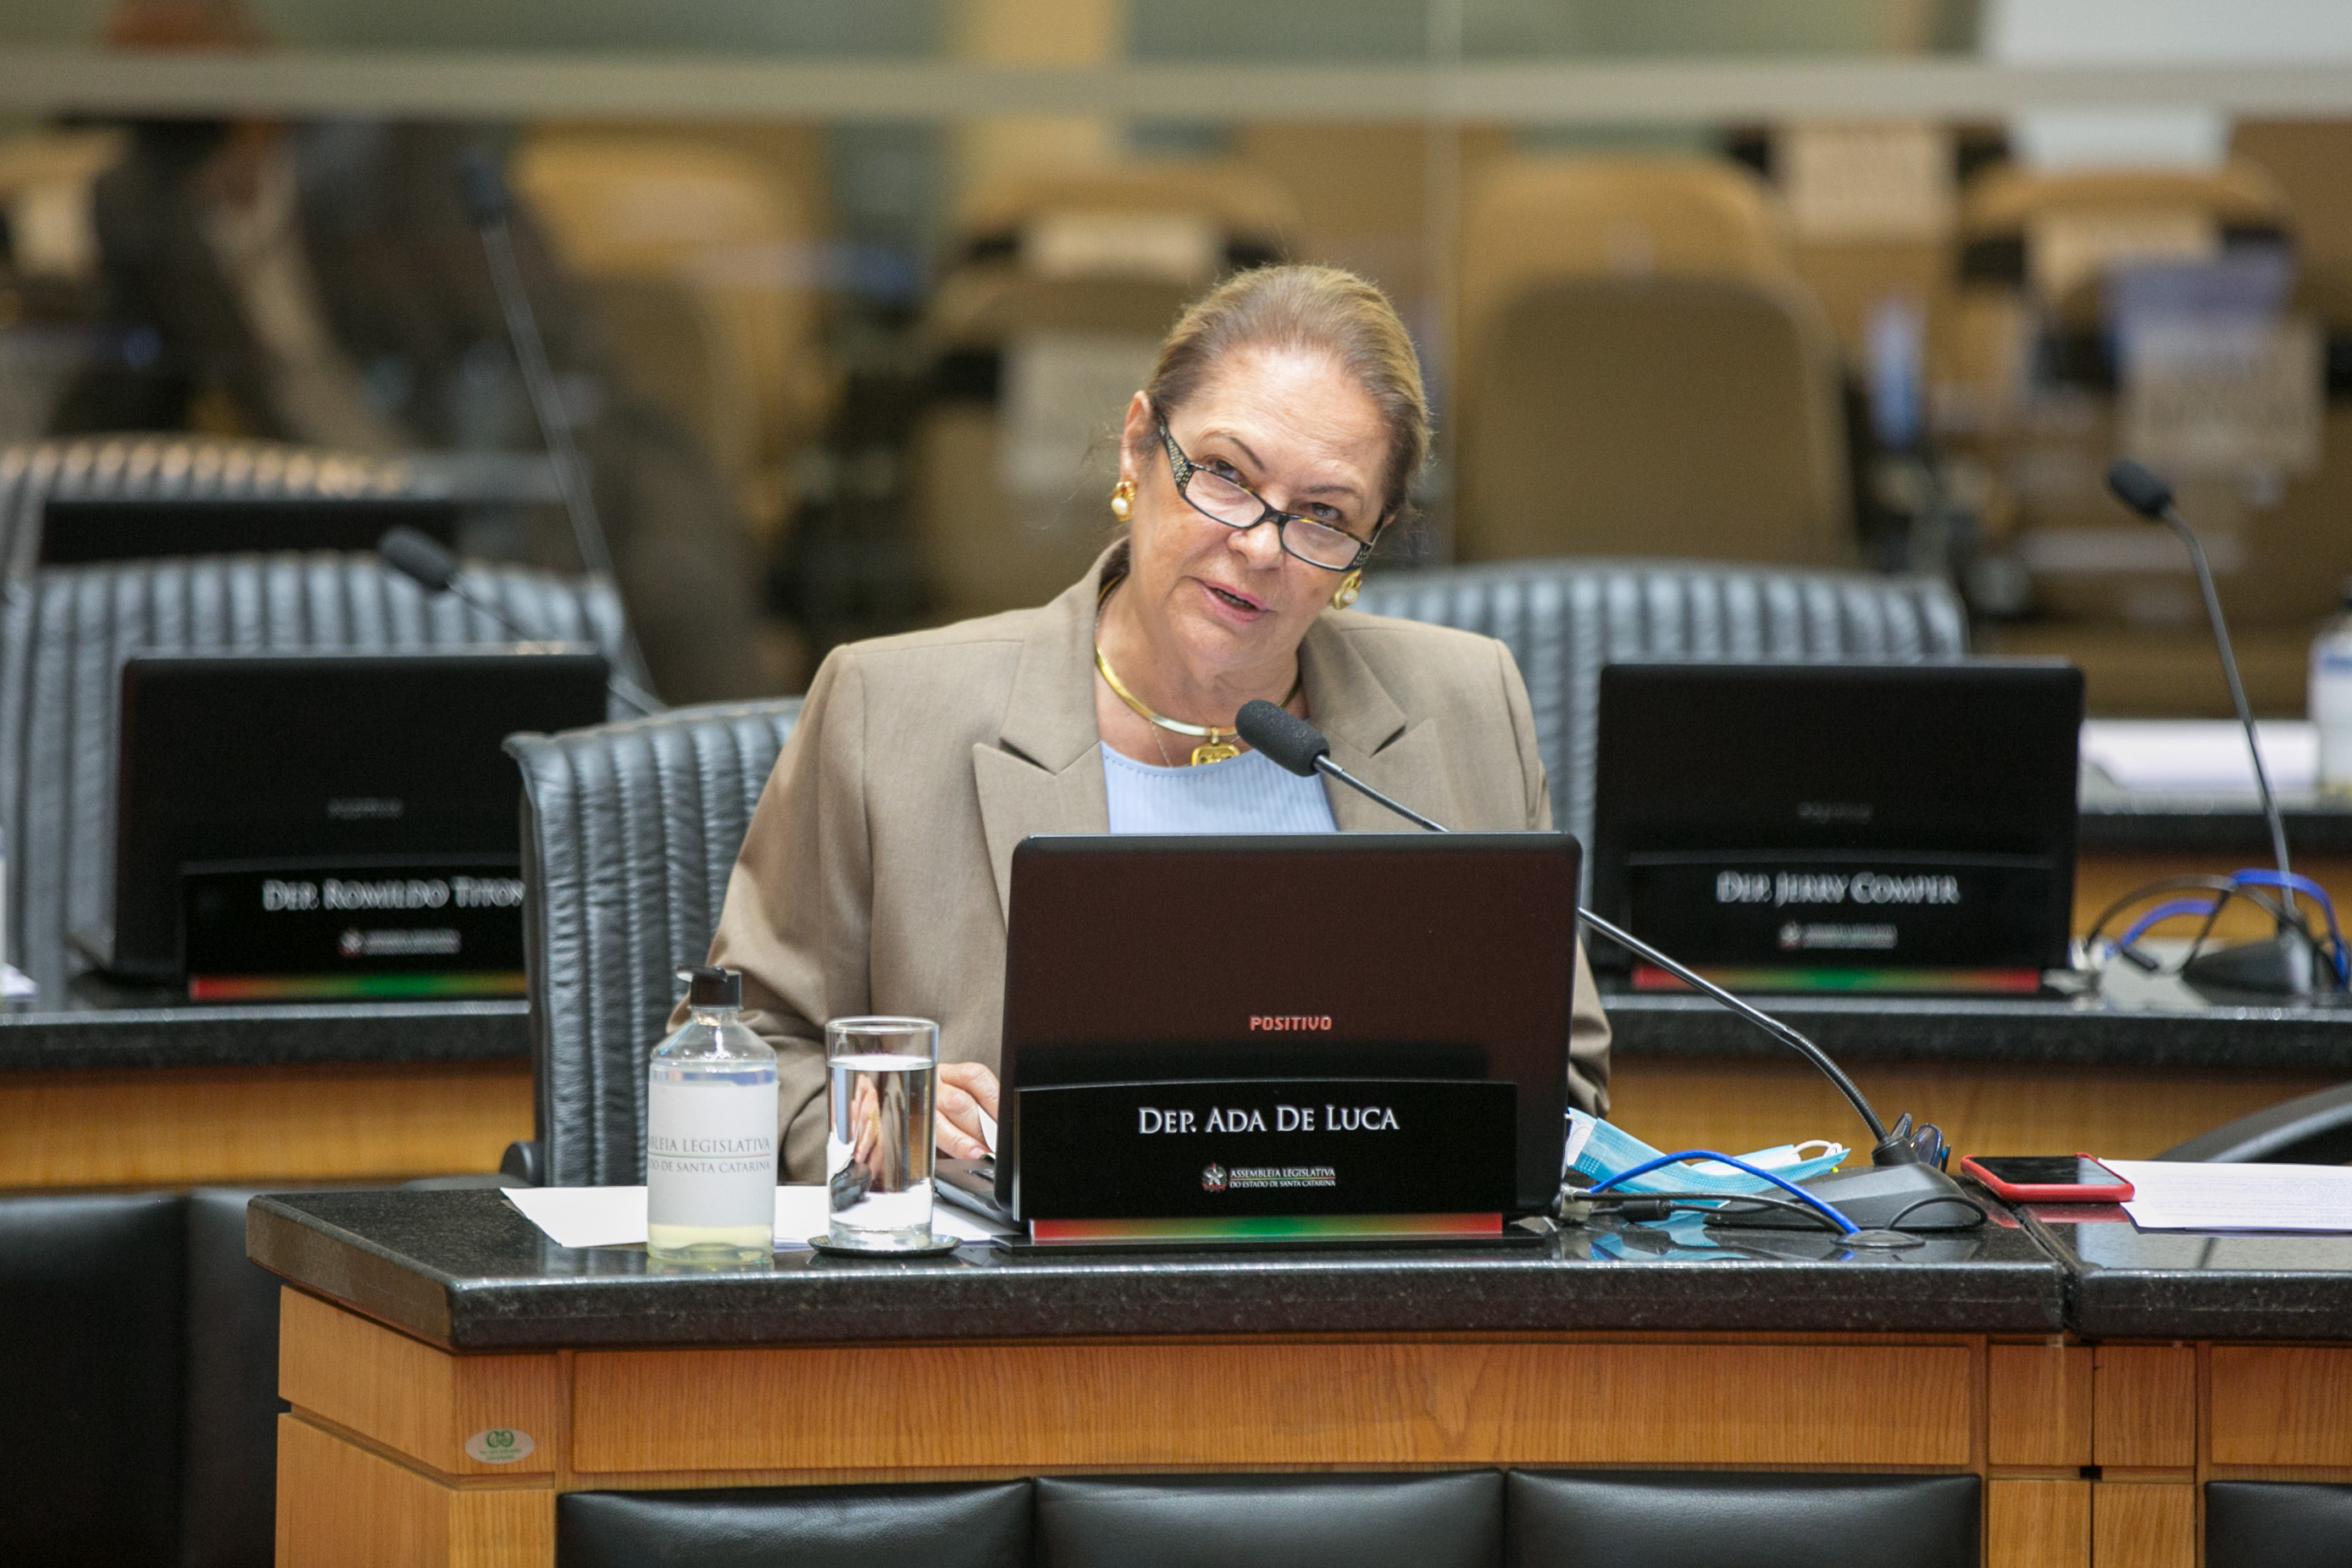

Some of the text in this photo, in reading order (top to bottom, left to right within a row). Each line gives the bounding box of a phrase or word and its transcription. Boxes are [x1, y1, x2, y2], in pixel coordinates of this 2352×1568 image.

[1250, 1016, 1333, 1031] POSITIVO
[1205, 1105, 1268, 1133] ADA
[1276, 1104, 1315, 1132] DE
[1325, 1104, 1401, 1131] LUCA
[649, 1136, 770, 1153] BLEIA LEGISLATIVA
[661, 1161, 673, 1172] DE
[677, 1161, 715, 1173] SANTA
[719, 1161, 770, 1173] CATARINA
[1230, 1167, 1335, 1177] ASSEMBLEIA LEGISLATIVA
[1302, 1178, 1336, 1187] CATARINA
